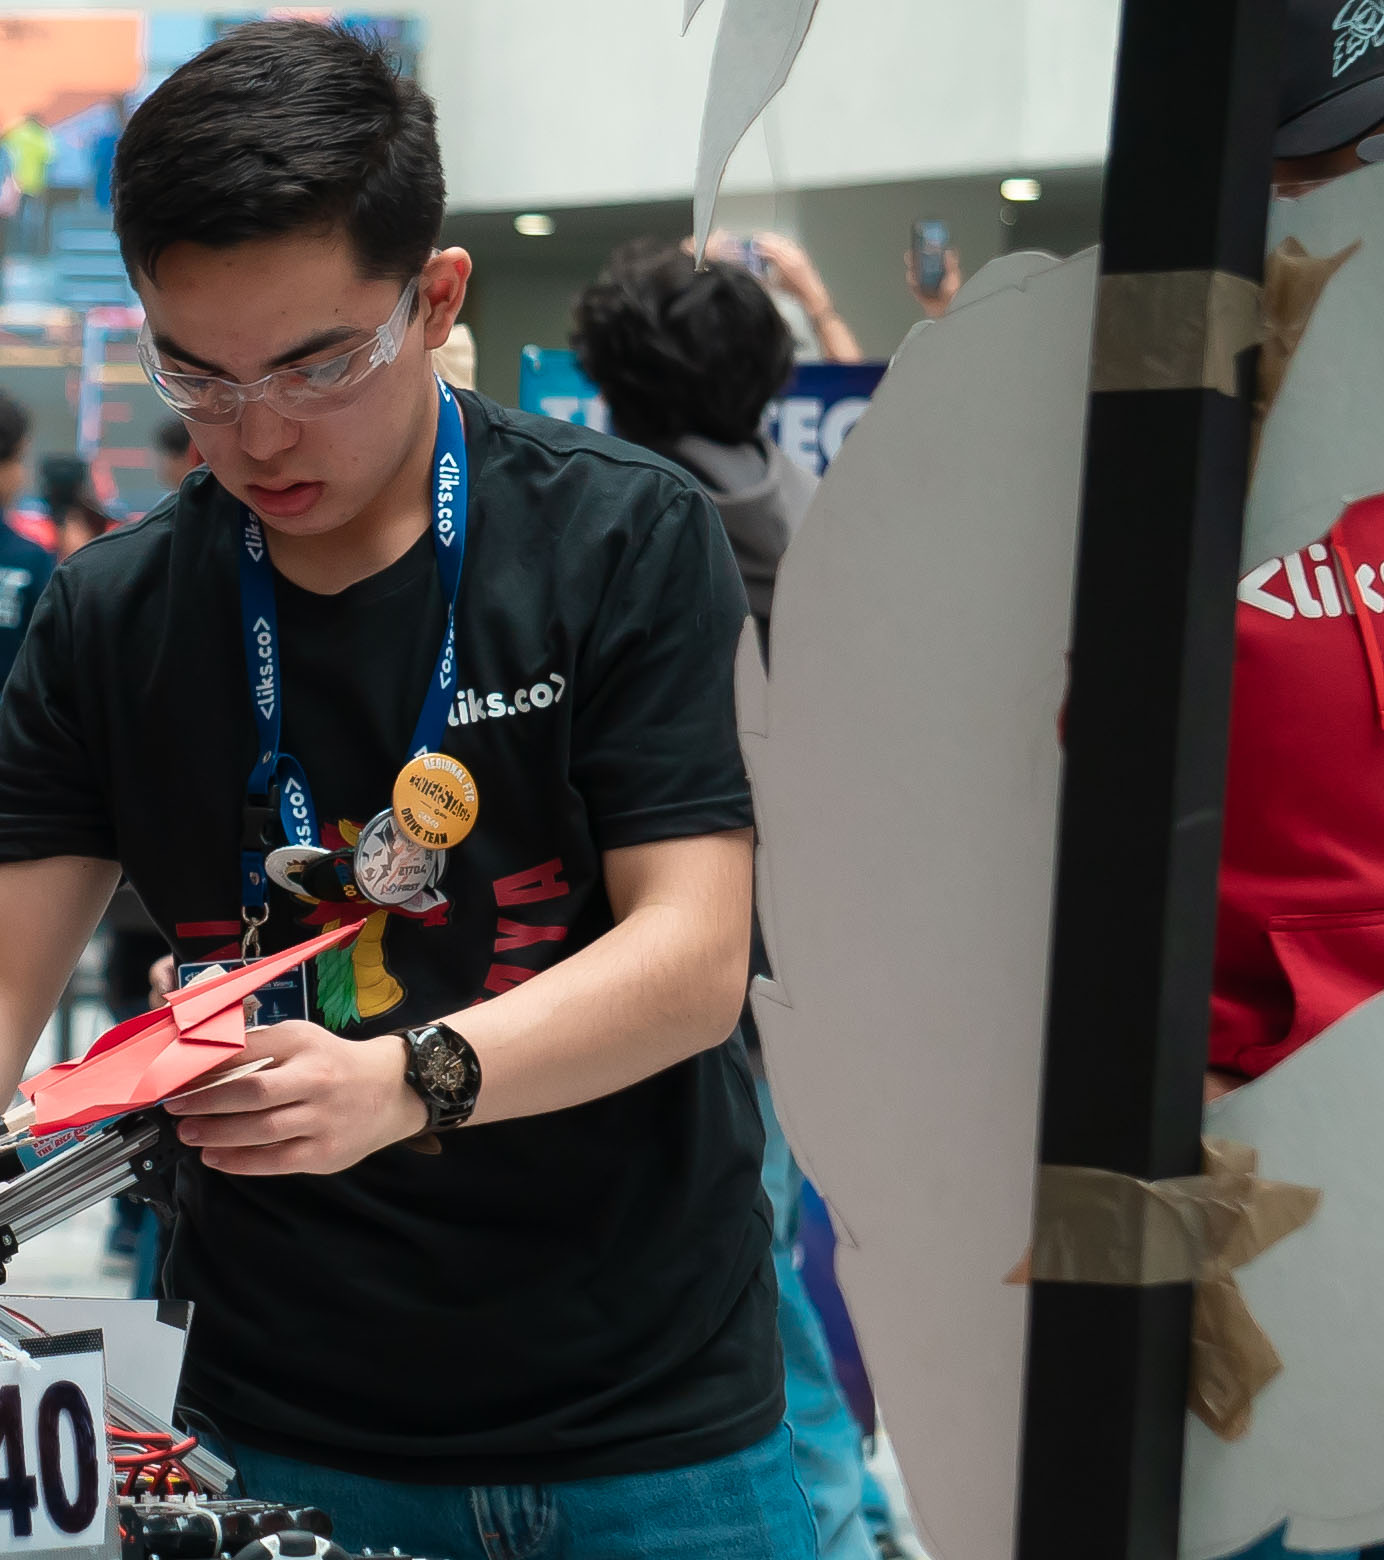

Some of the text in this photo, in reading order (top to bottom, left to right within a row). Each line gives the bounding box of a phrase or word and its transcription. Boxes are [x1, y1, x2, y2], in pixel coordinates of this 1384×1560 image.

[448, 672, 566, 727] liks.co>
[401, 807, 423, 837] DRIVE
[422, 830, 449, 845] TEAM
